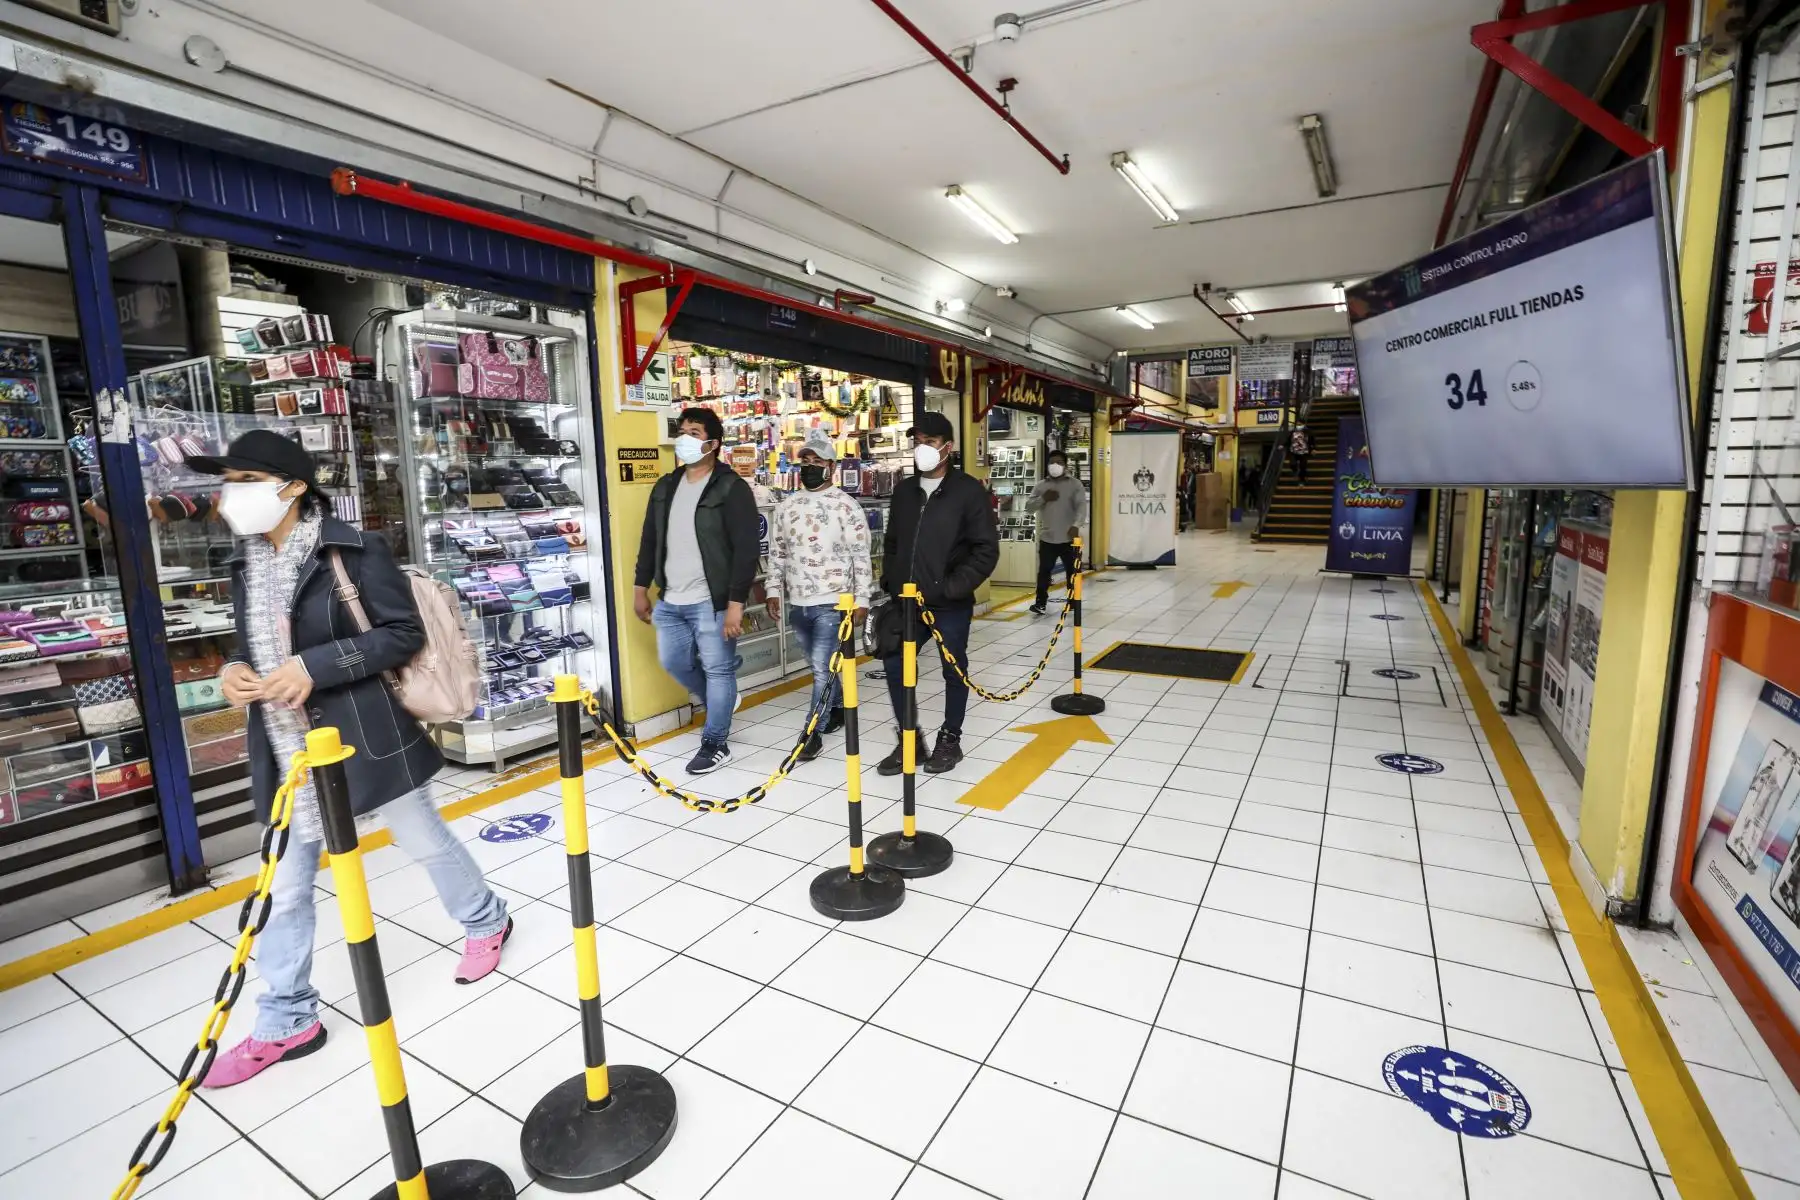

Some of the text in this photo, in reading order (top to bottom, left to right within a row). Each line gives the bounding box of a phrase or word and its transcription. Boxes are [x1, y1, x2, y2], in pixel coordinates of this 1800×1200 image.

[57, 115, 130, 152] 149
[60, 147, 99, 160] REDONDA
[1421, 232, 1528, 282] SISTEMA CONTROL AFORO
[780, 308, 796, 320] 148
[1386, 285, 1584, 353] CENTRO COMERCIAL FULL TIENDAS
[1315, 340, 1338, 351] AFORO
[1190, 349, 1229, 360] AFORO
[1445, 369, 1487, 410] 34
[646, 391, 669, 402] SALIDA
[1259, 411, 1278, 421] BAÑO
[619, 449, 657, 458] PRECAUCIÓN
[1118, 502, 1166, 514] LIMA
[1363, 530, 1403, 541] LIMA
[1420, 1066, 1437, 1077] 1
[1475, 1063, 1527, 1137] MANTEN TU DISTACIA
